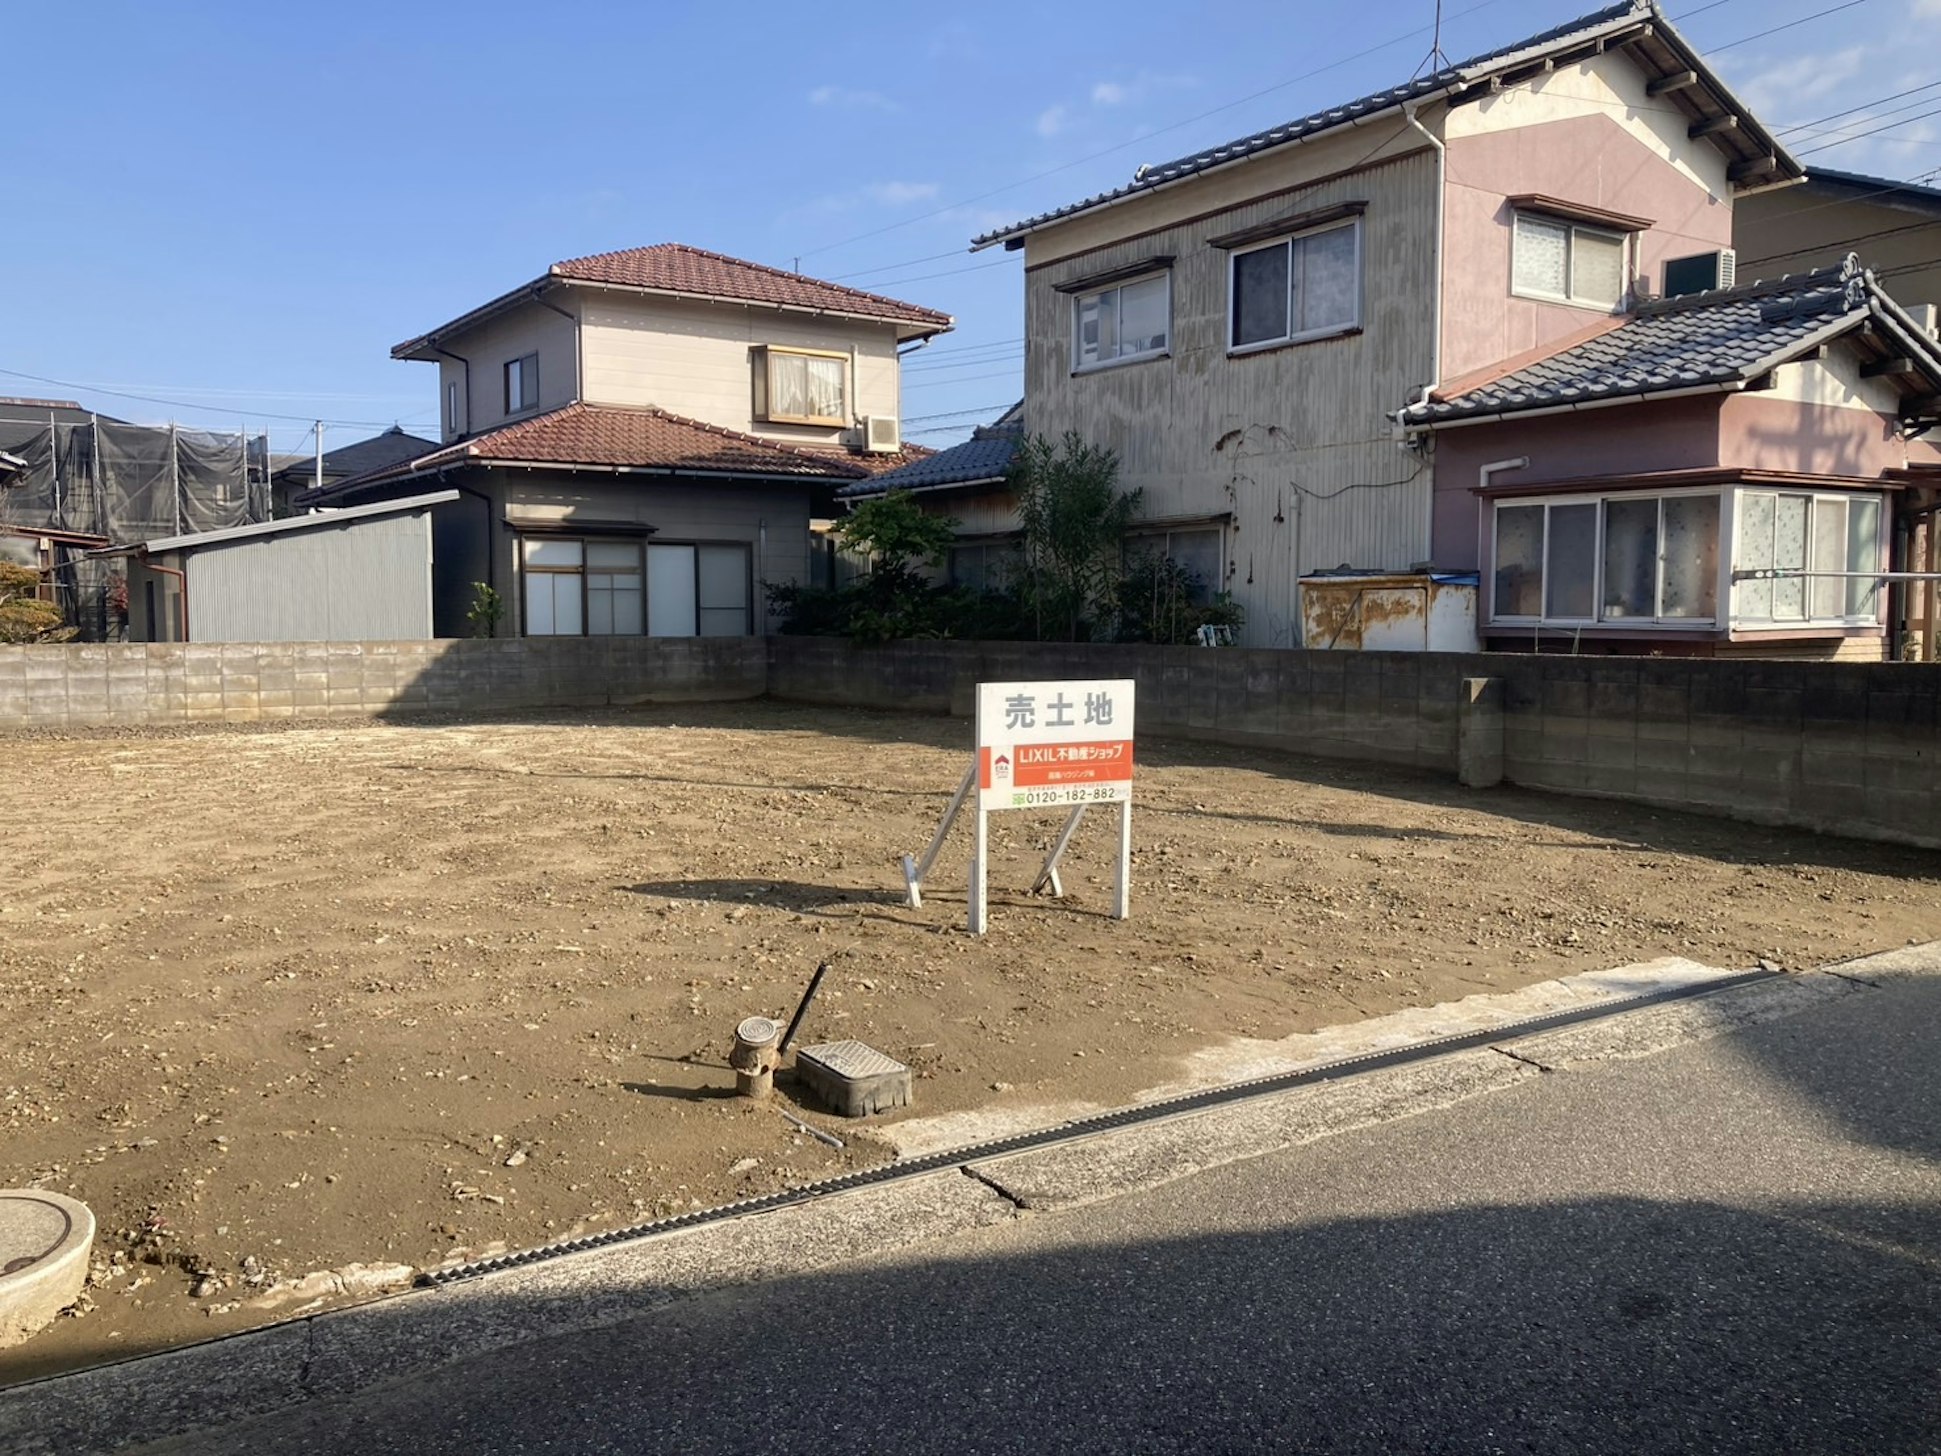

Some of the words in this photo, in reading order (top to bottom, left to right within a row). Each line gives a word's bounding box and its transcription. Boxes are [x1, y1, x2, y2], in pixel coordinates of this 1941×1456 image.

[1005, 692, 1113, 730] 売土地
[1020, 744, 1123, 763] LIXIL不動産ショップ
[1026, 788, 1115, 804] 0120-182-882
